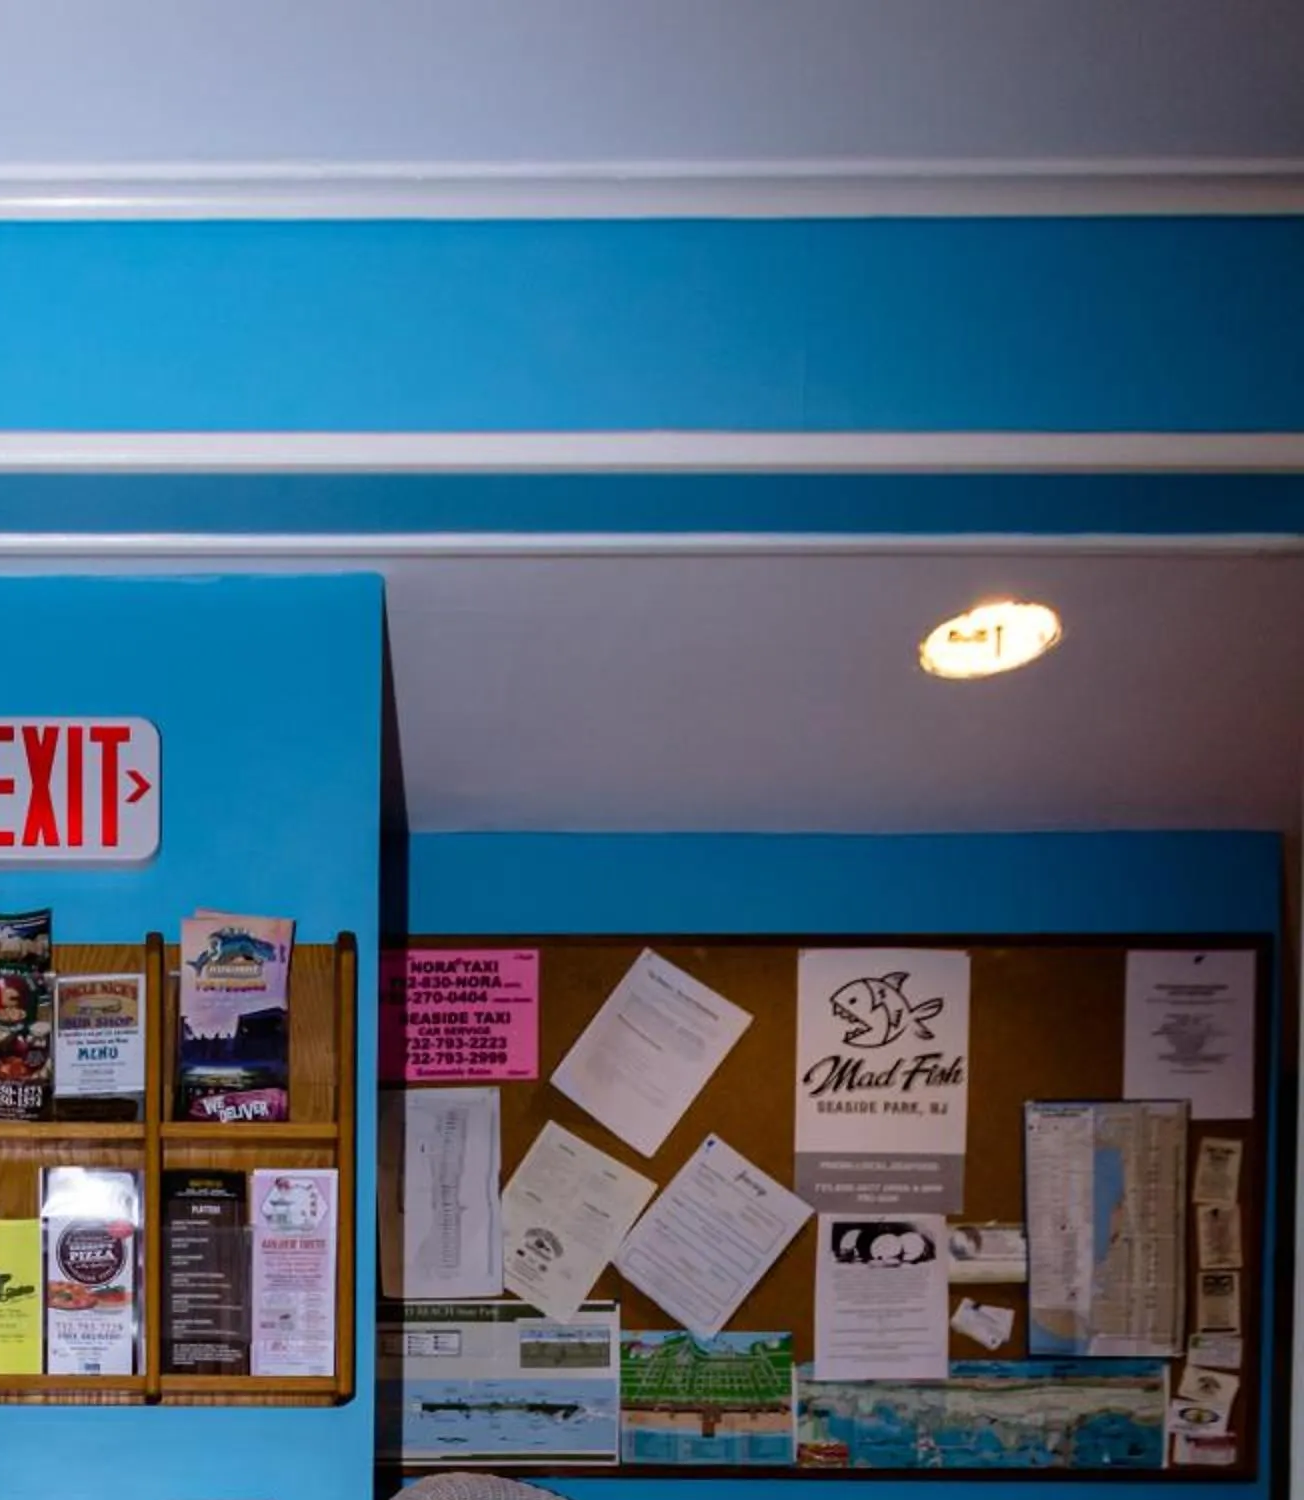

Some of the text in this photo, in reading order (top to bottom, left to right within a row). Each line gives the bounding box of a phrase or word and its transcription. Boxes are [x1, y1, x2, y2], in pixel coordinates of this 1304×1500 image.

[411, 961, 498, 973] NORA TAXI
[474, 1012, 511, 1024] TAXI
[78, 1046, 118, 1060] MENU
[803, 1053, 964, 1097] Mad Fish
[219, 1101, 269, 1123] DELIVER
[817, 1100, 949, 1116] SEASIDE PARK, NJ
